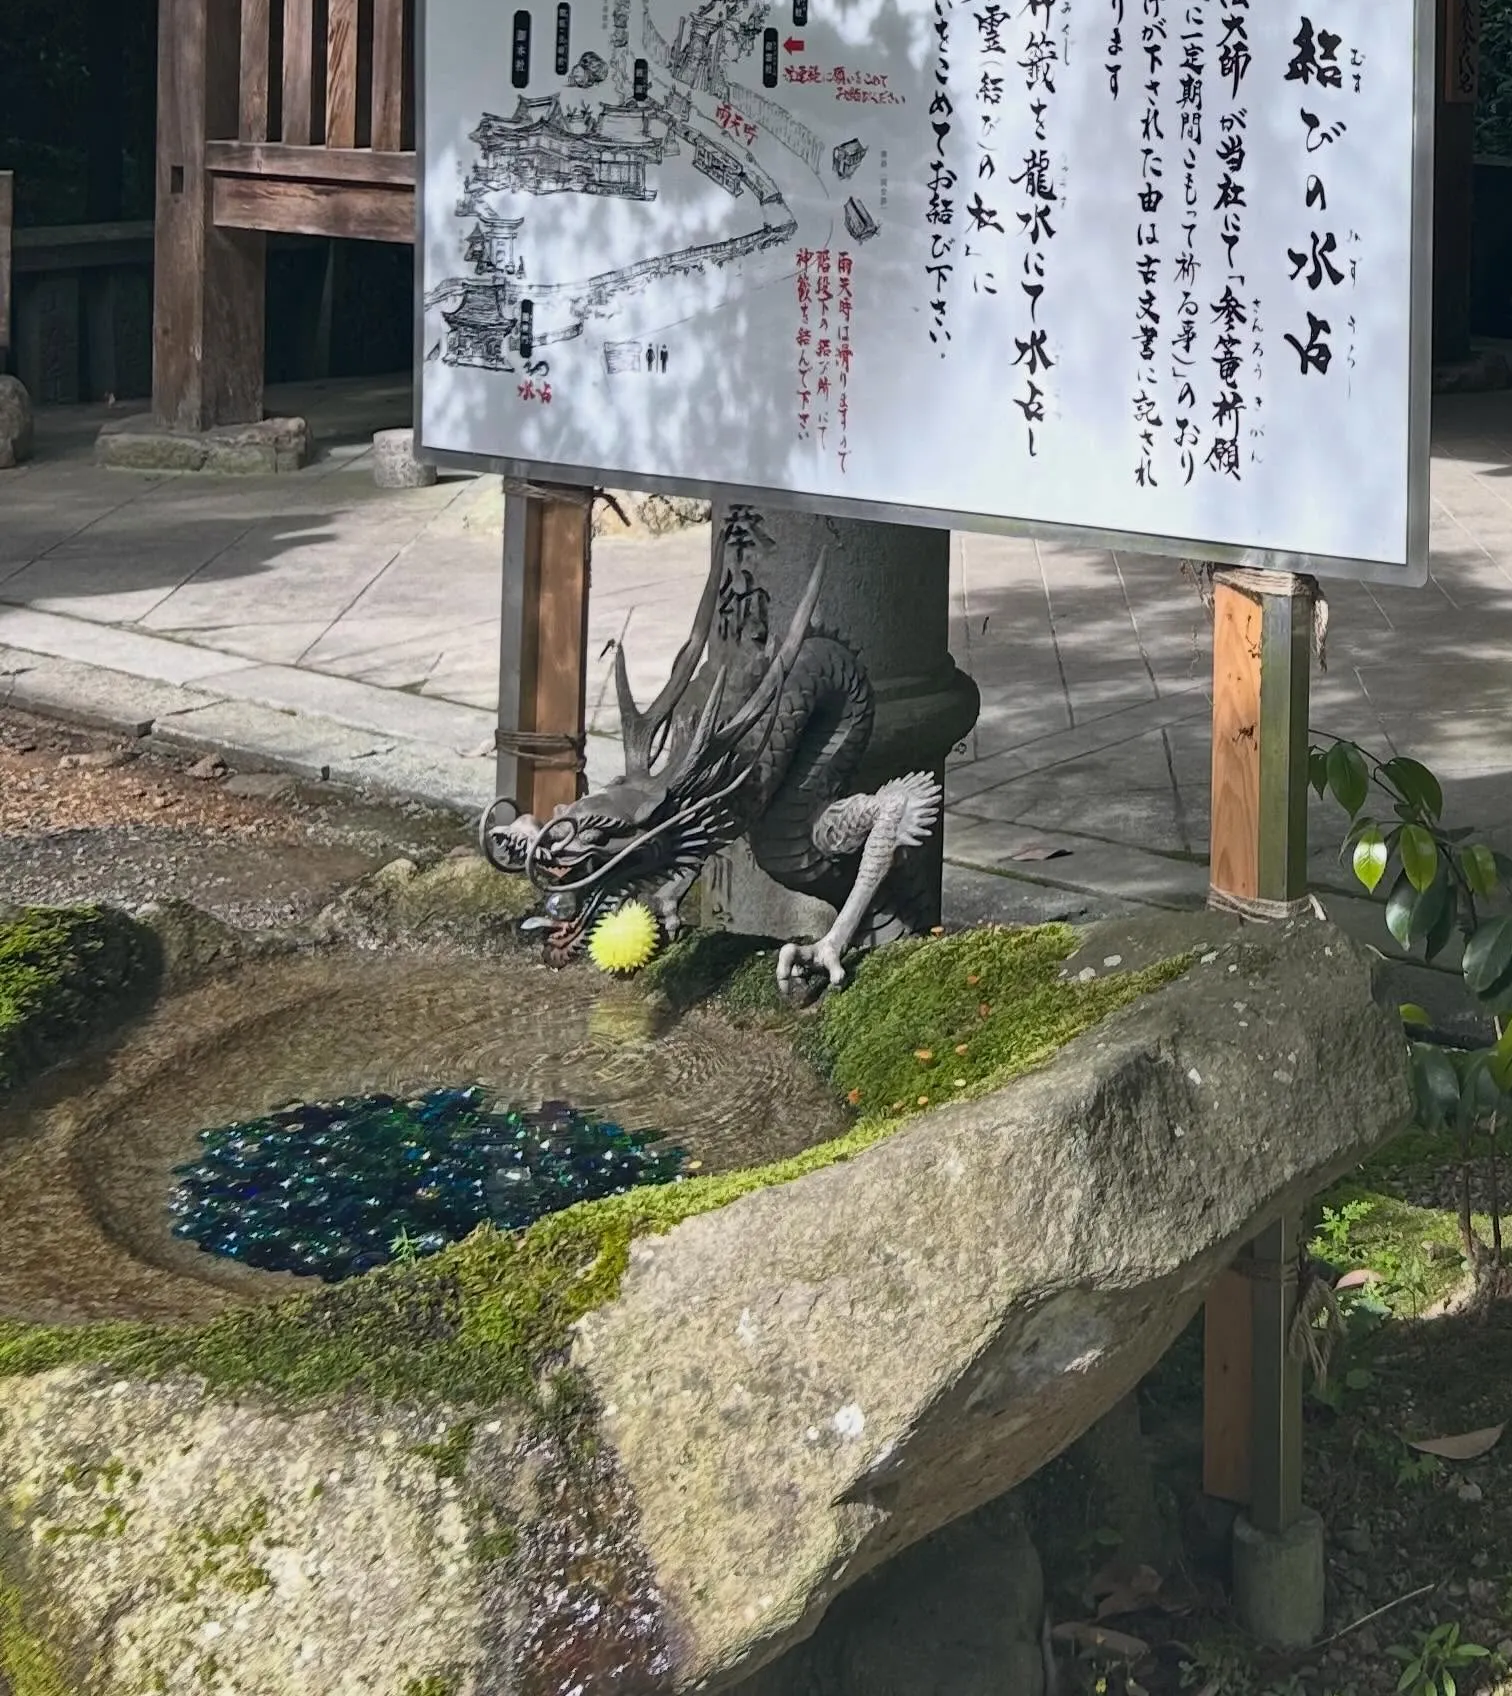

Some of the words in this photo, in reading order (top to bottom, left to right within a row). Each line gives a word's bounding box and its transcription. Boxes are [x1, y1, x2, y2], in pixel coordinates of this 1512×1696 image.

[715, 102, 759, 145] 雨天時
[1283, 15, 1347, 375] 結びの水占
[517, 380, 552, 403] 水占
[835, 251, 853, 474] 雨天時は滑りますので
[720, 503, 776, 645] 奉納
